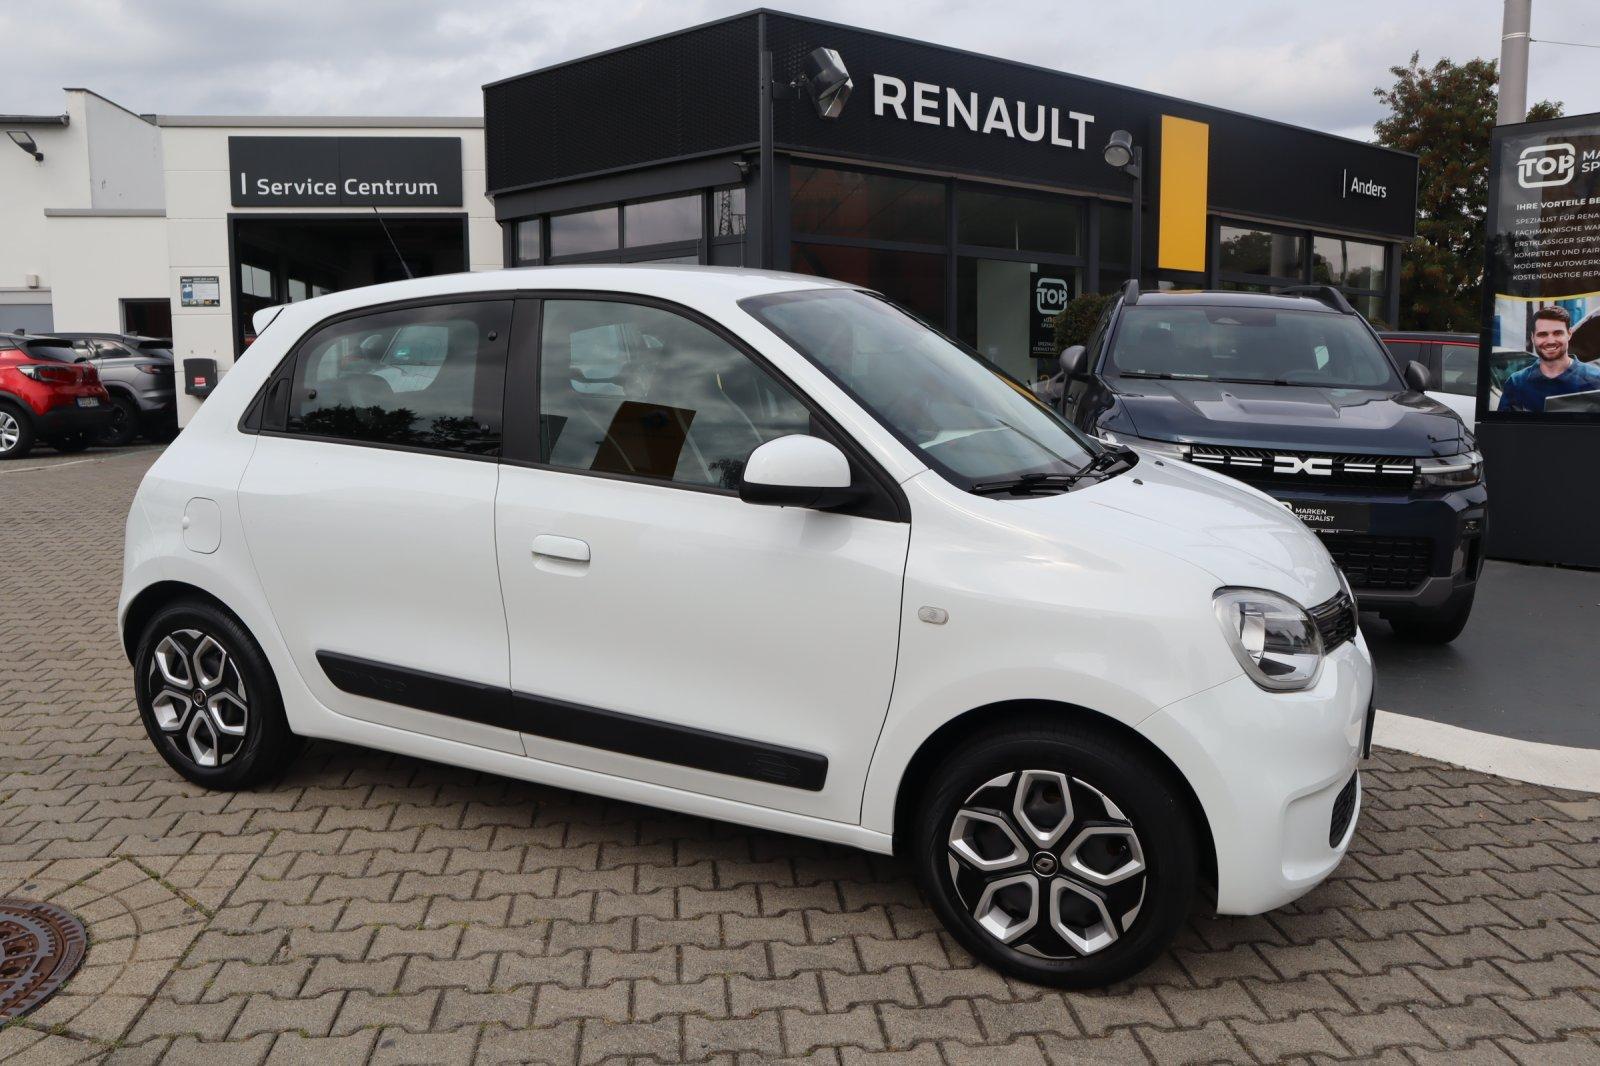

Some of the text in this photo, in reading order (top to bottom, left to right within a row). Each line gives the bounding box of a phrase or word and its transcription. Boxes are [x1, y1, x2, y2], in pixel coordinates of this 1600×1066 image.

[873, 73, 1095, 150] RENAULT
[1516, 154, 1575, 177] TOP
[257, 178, 438, 195] Service Centrum
[1350, 176, 1387, 198] Anders
[1516, 202, 1538, 211] IHRE
[1540, 198, 1586, 208] VORTEILE
[1515, 216, 1557, 225] SPEZIALIST
[1559, 213, 1575, 221] FÜR
[1515, 225, 1582, 236] FACHMÄNNISCHE
[1514, 237, 1574, 248] ERSTKLASSIGER
[1514, 249, 1560, 258] KOMPETENT
[1513, 261, 1552, 270] MODERNE
[1513, 270, 1581, 281] KOSTENGÜNSTIGE
[1036, 288, 1067, 305] TOP
[1295, 507, 1327, 515] MARKEN
